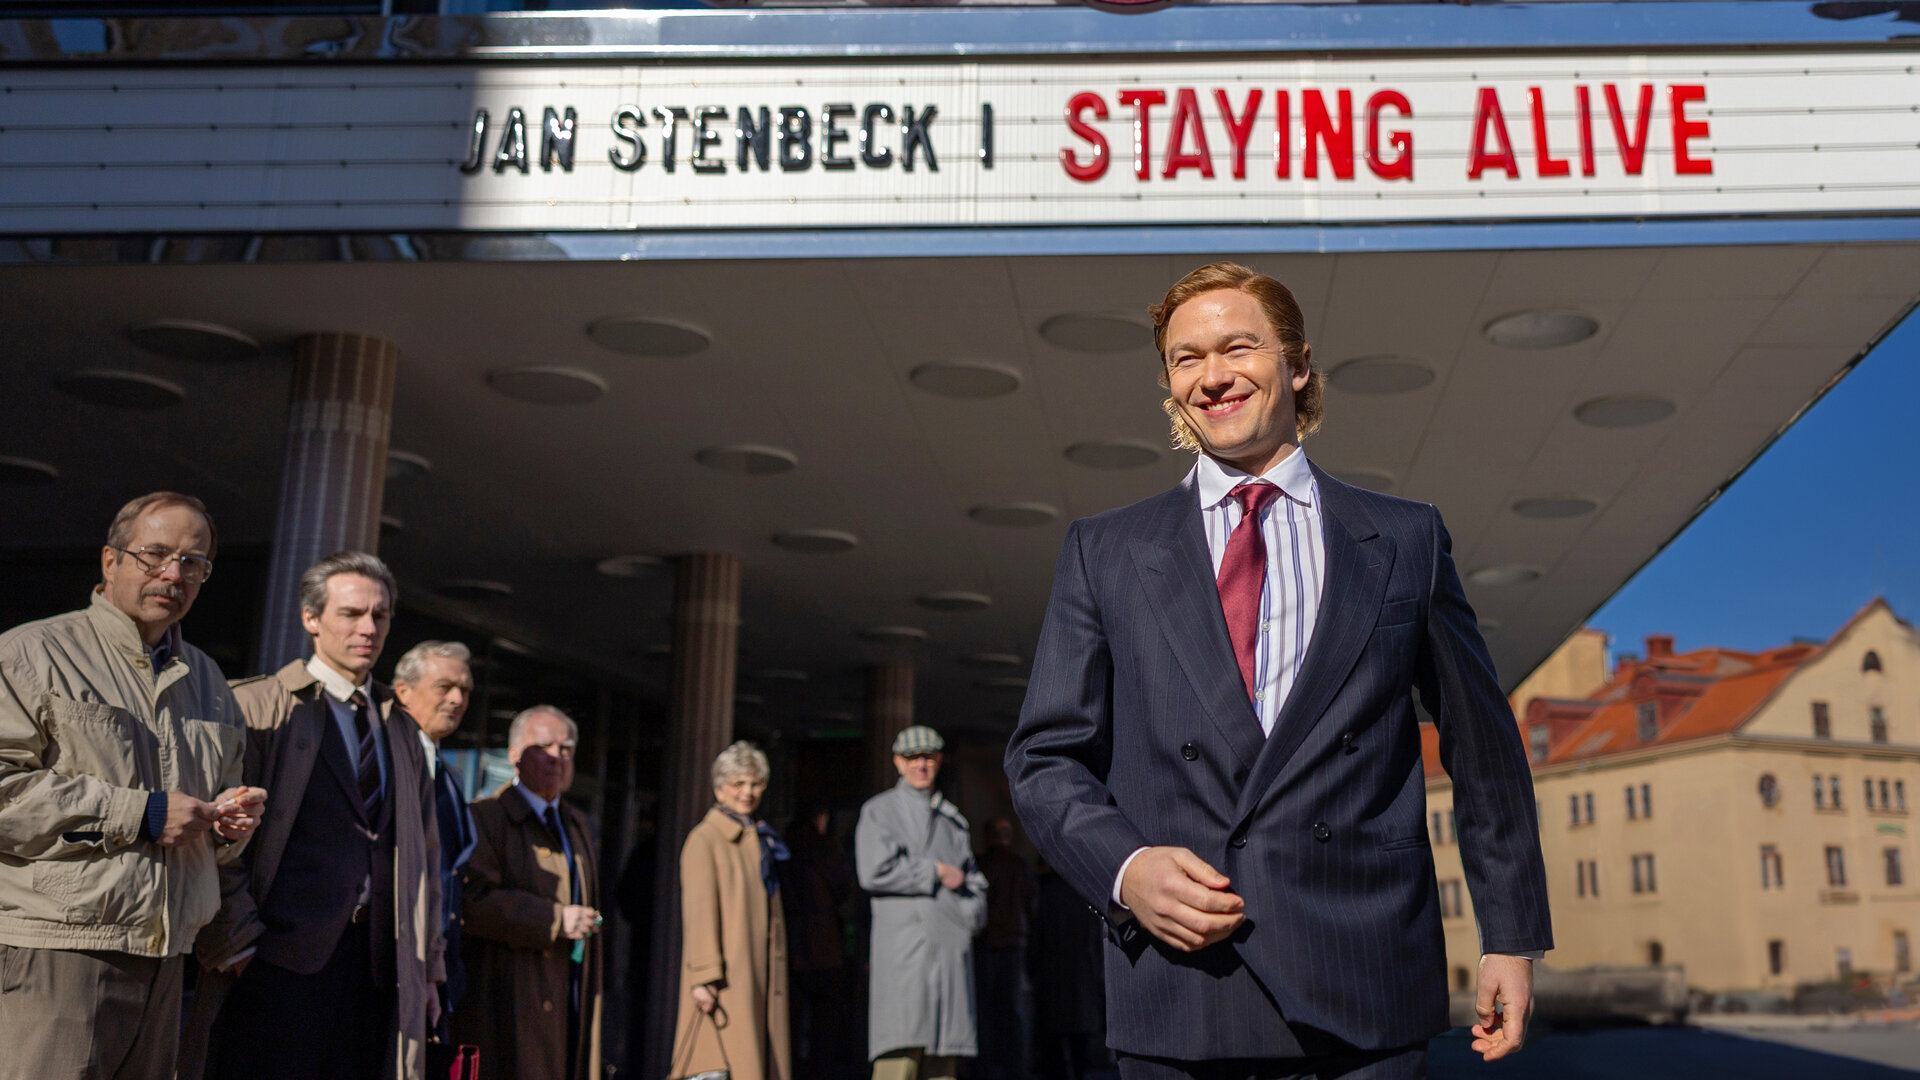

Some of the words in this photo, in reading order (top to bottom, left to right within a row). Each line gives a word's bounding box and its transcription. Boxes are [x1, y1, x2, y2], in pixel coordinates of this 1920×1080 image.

[460, 106, 577, 174] JAN
[607, 103, 940, 173] STENBECK
[980, 103, 995, 169] I
[1059, 88, 1415, 182] STAYING
[1468, 84, 1714, 178] ALIVE
